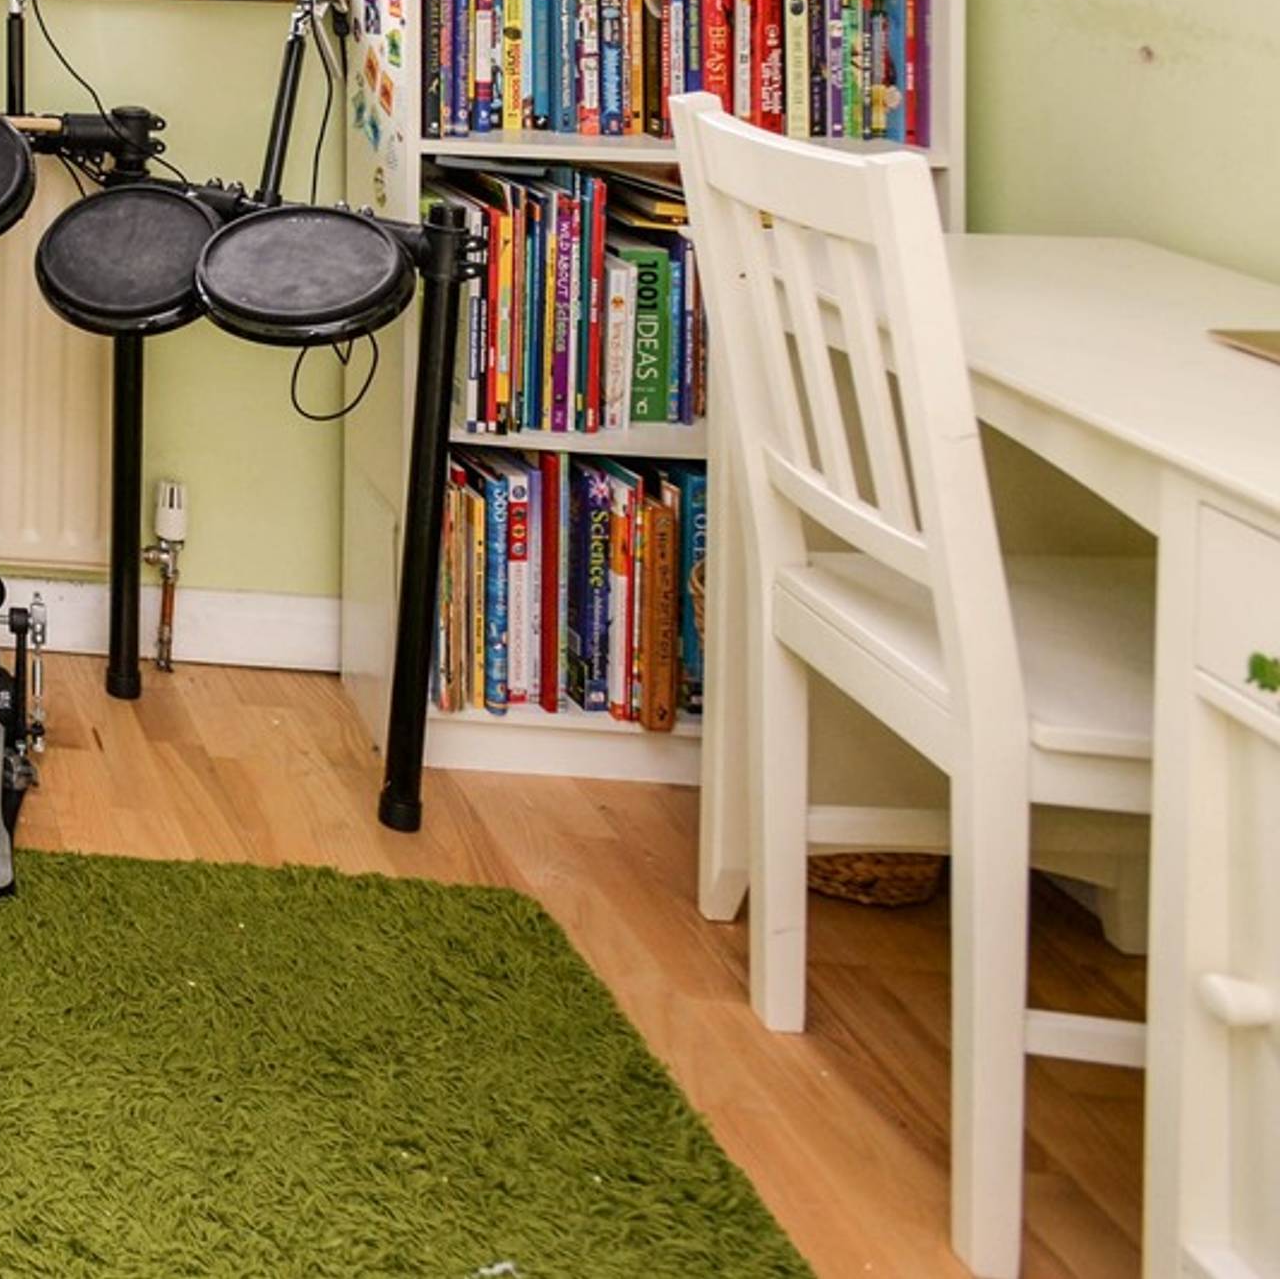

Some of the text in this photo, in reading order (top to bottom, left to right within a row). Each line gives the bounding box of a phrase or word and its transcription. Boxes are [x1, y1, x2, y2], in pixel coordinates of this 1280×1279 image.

[706, 25, 727, 85] BEAST
[559, 221, 571, 251] WILD
[557, 254, 569, 298] ABOUT
[636, 260, 659, 380] 1001 IDEAS
[590, 509, 610, 588] Science
